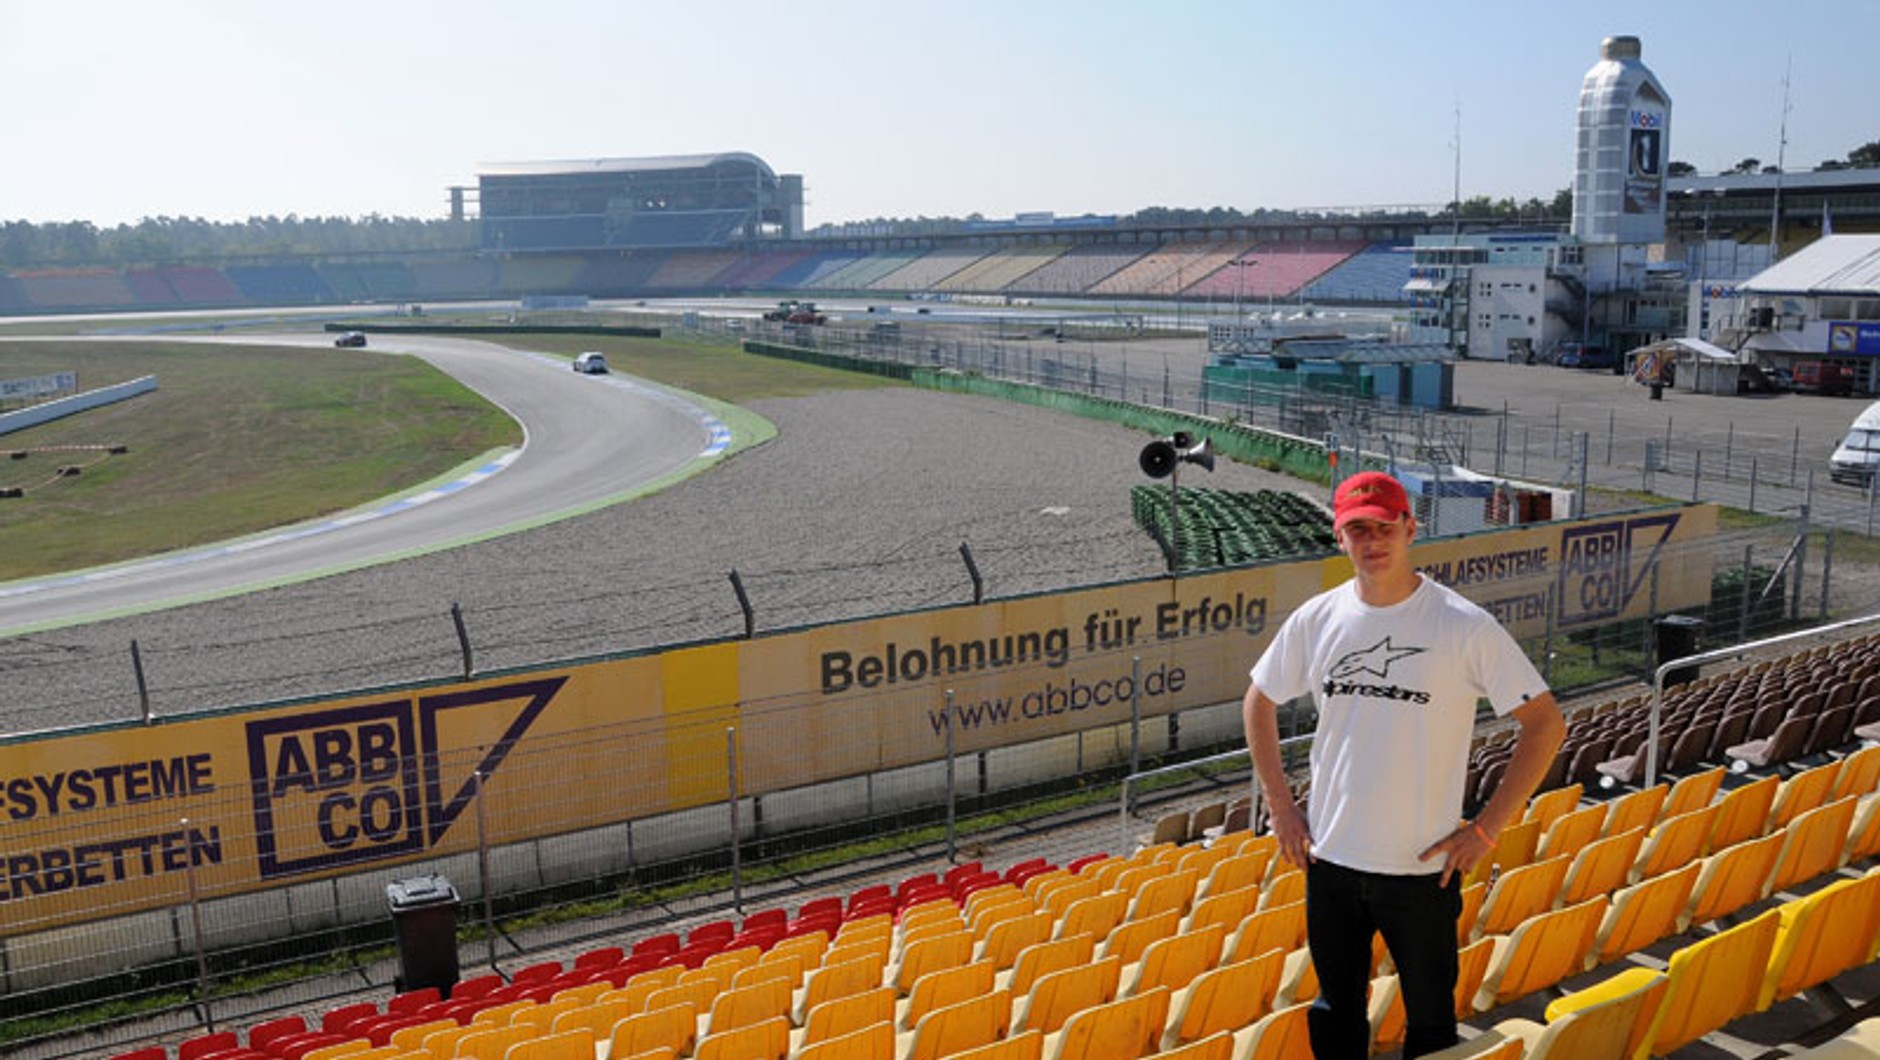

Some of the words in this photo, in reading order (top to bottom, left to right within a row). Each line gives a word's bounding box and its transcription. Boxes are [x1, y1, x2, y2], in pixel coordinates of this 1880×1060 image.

[1568, 534, 1616, 575] ABB
[1580, 572, 1615, 610] CO
[821, 625, 1069, 695] Belohnung
[1084, 611, 1142, 653] für
[1156, 593, 1268, 640] Erfolg
[928, 662, 1187, 736] www.abbco.de
[0, 753, 217, 820] SYSTEME
[272, 723, 400, 798] ABB
[317, 787, 402, 849] CO
